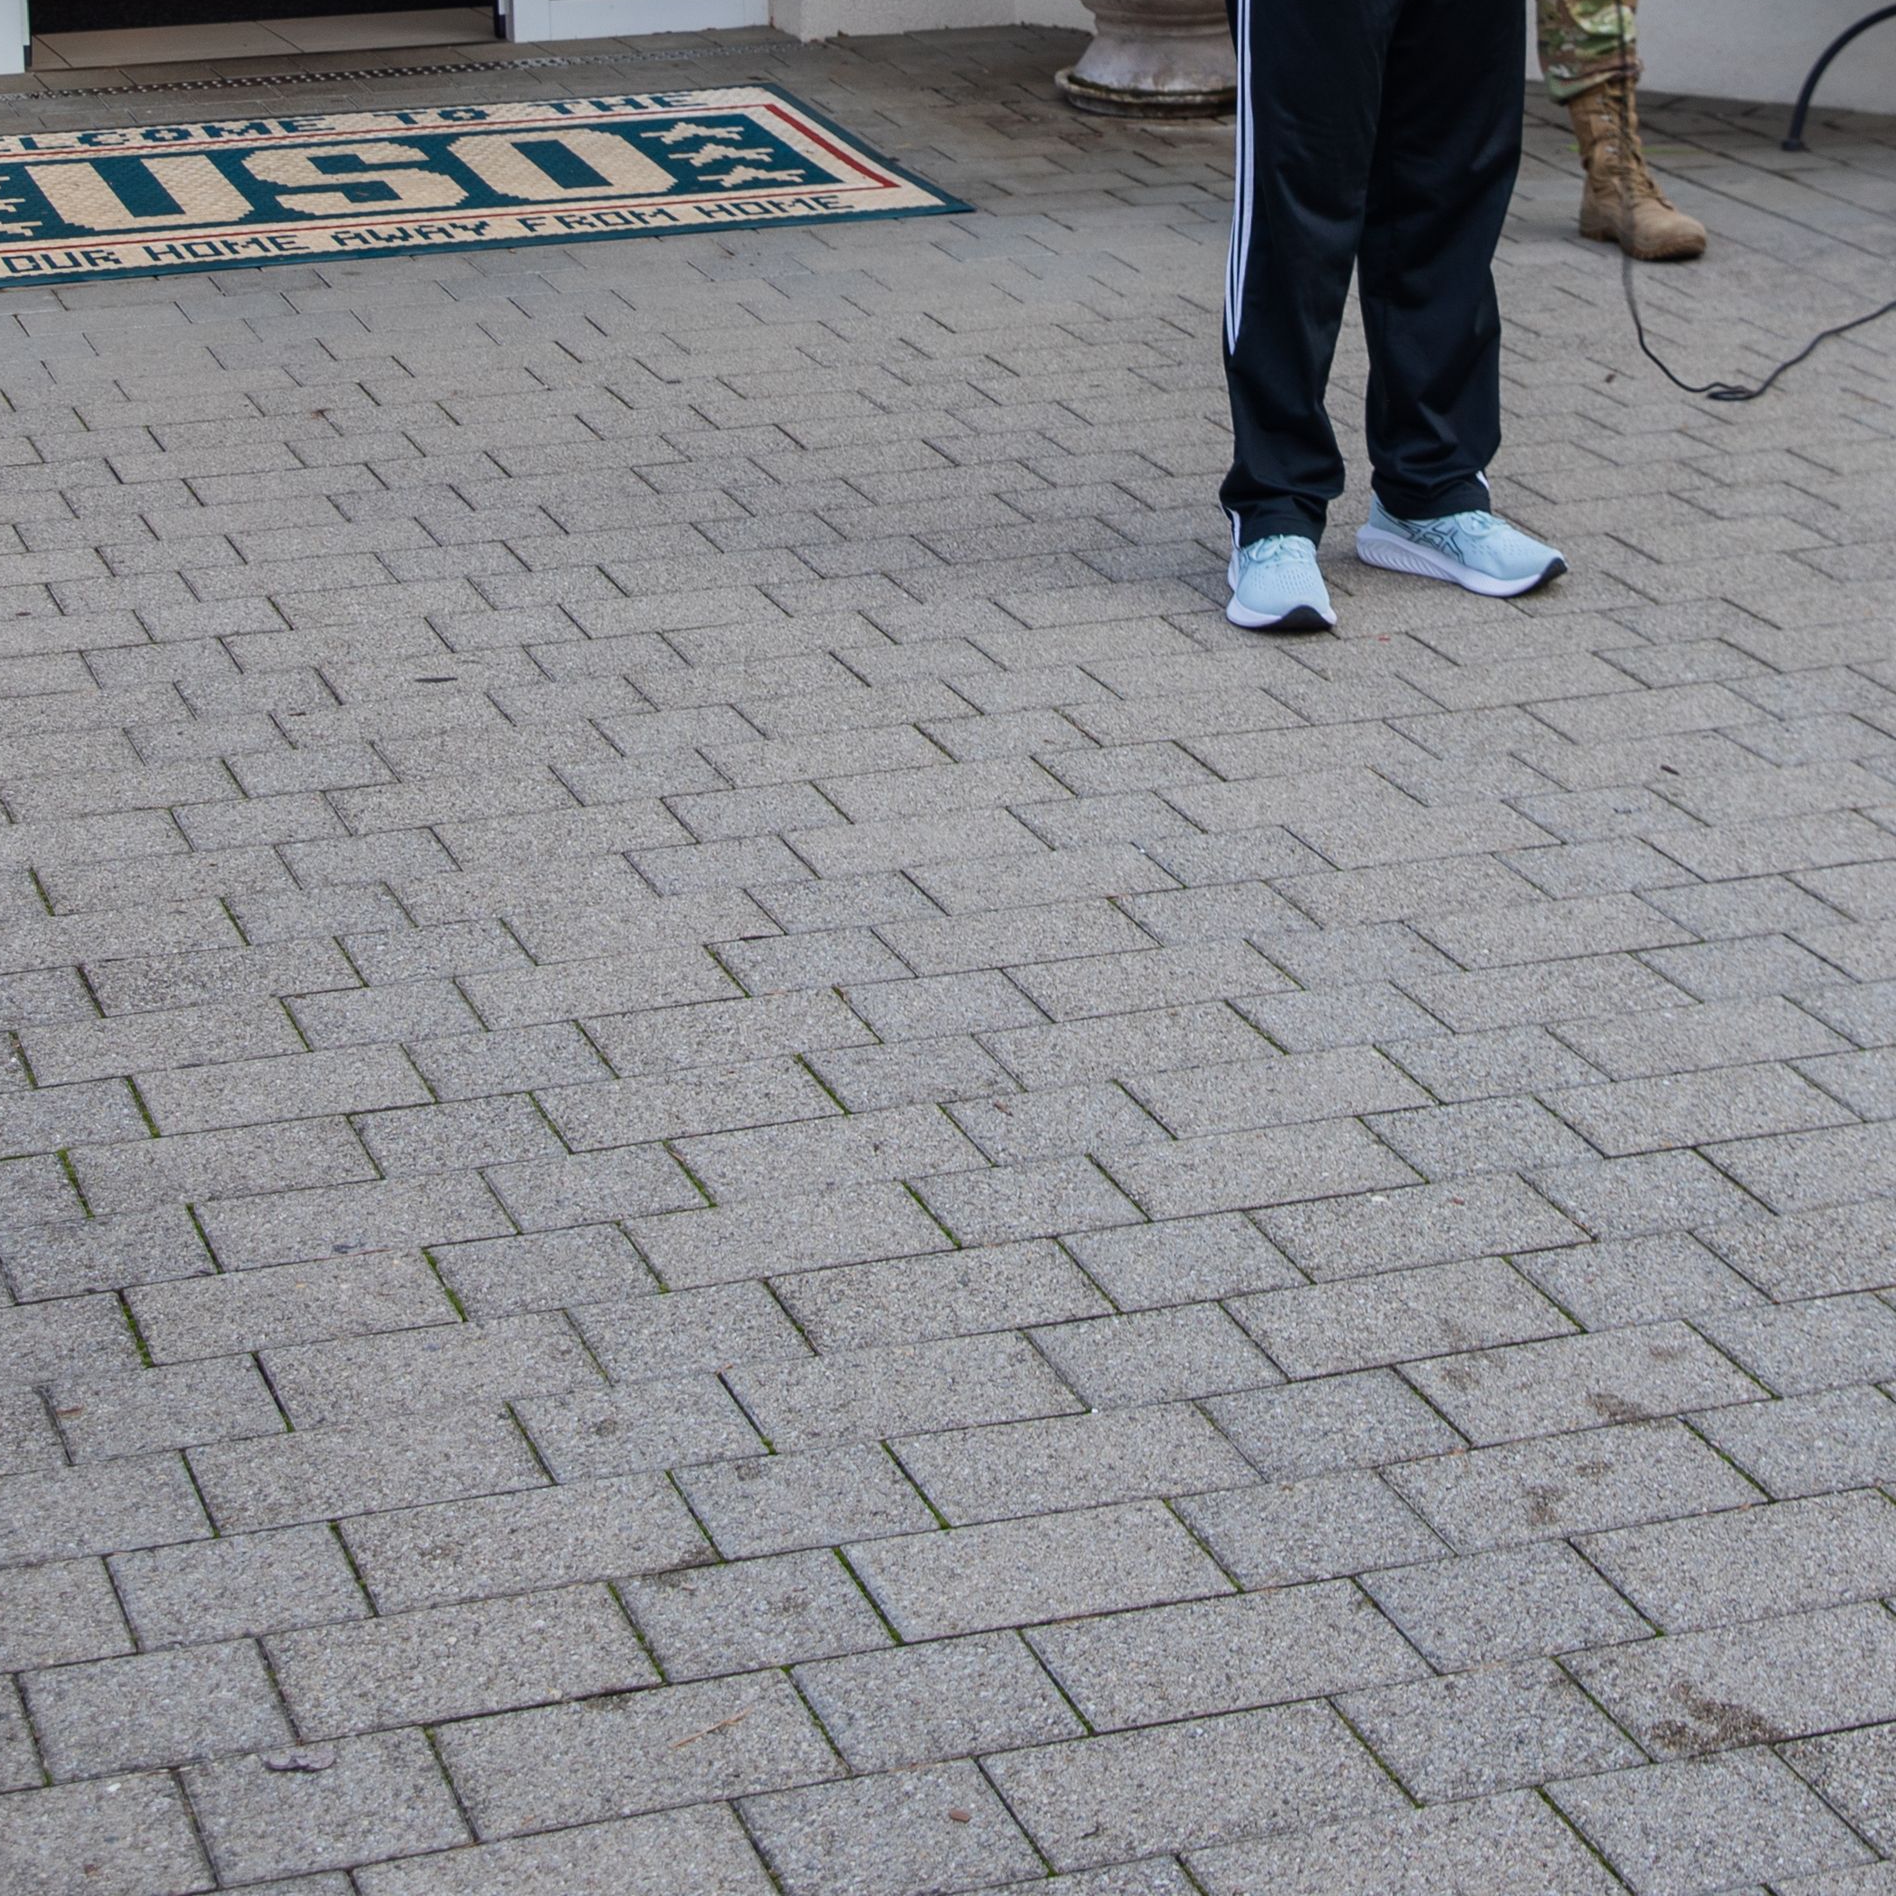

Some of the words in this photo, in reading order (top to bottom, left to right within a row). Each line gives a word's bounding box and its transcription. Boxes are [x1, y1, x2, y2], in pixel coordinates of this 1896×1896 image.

[383, 106, 489, 128] TO
[529, 90, 709, 117] THE
[26, 129, 677, 232] USO
[144, 232, 300, 264] HOME
[327, 219, 489, 249] AWAY
[516, 204, 680, 236] FROM
[694, 191, 857, 222] HOME
